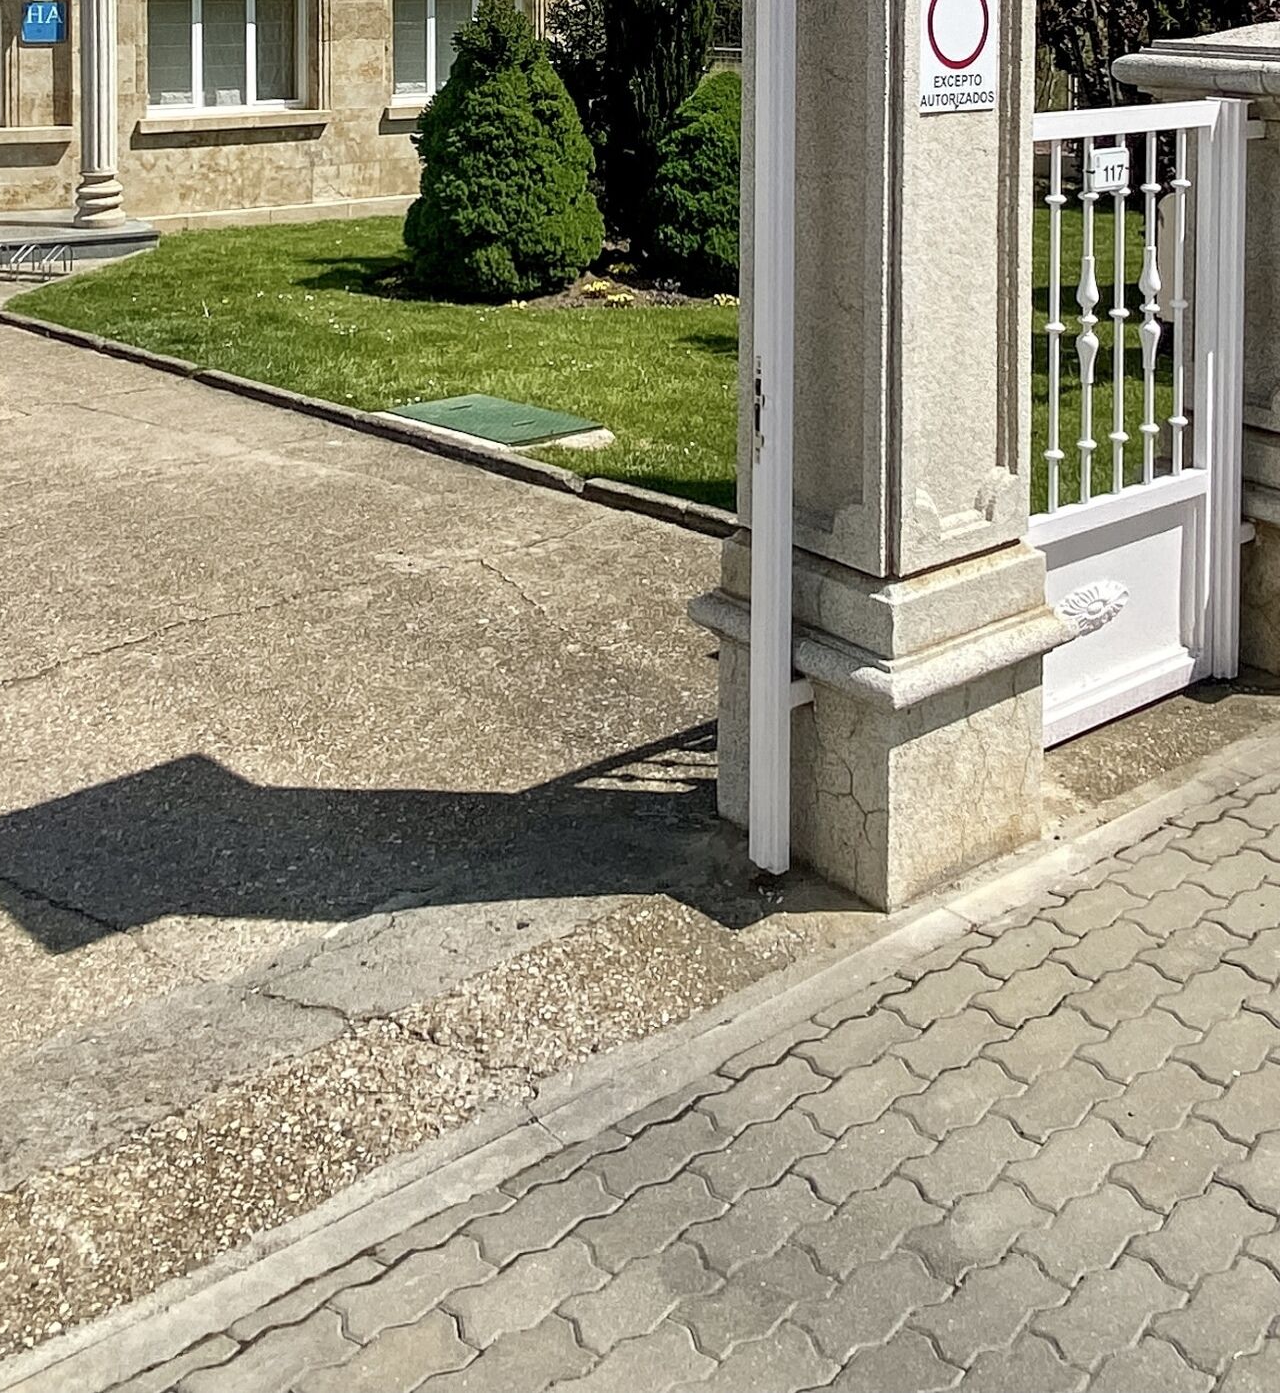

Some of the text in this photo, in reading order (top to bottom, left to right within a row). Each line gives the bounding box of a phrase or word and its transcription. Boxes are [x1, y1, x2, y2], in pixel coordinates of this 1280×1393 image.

[933, 74, 982, 88] EXCEPTO
[920, 91, 994, 106] AUTORIZADOS
[1103, 164, 1124, 182] 117
